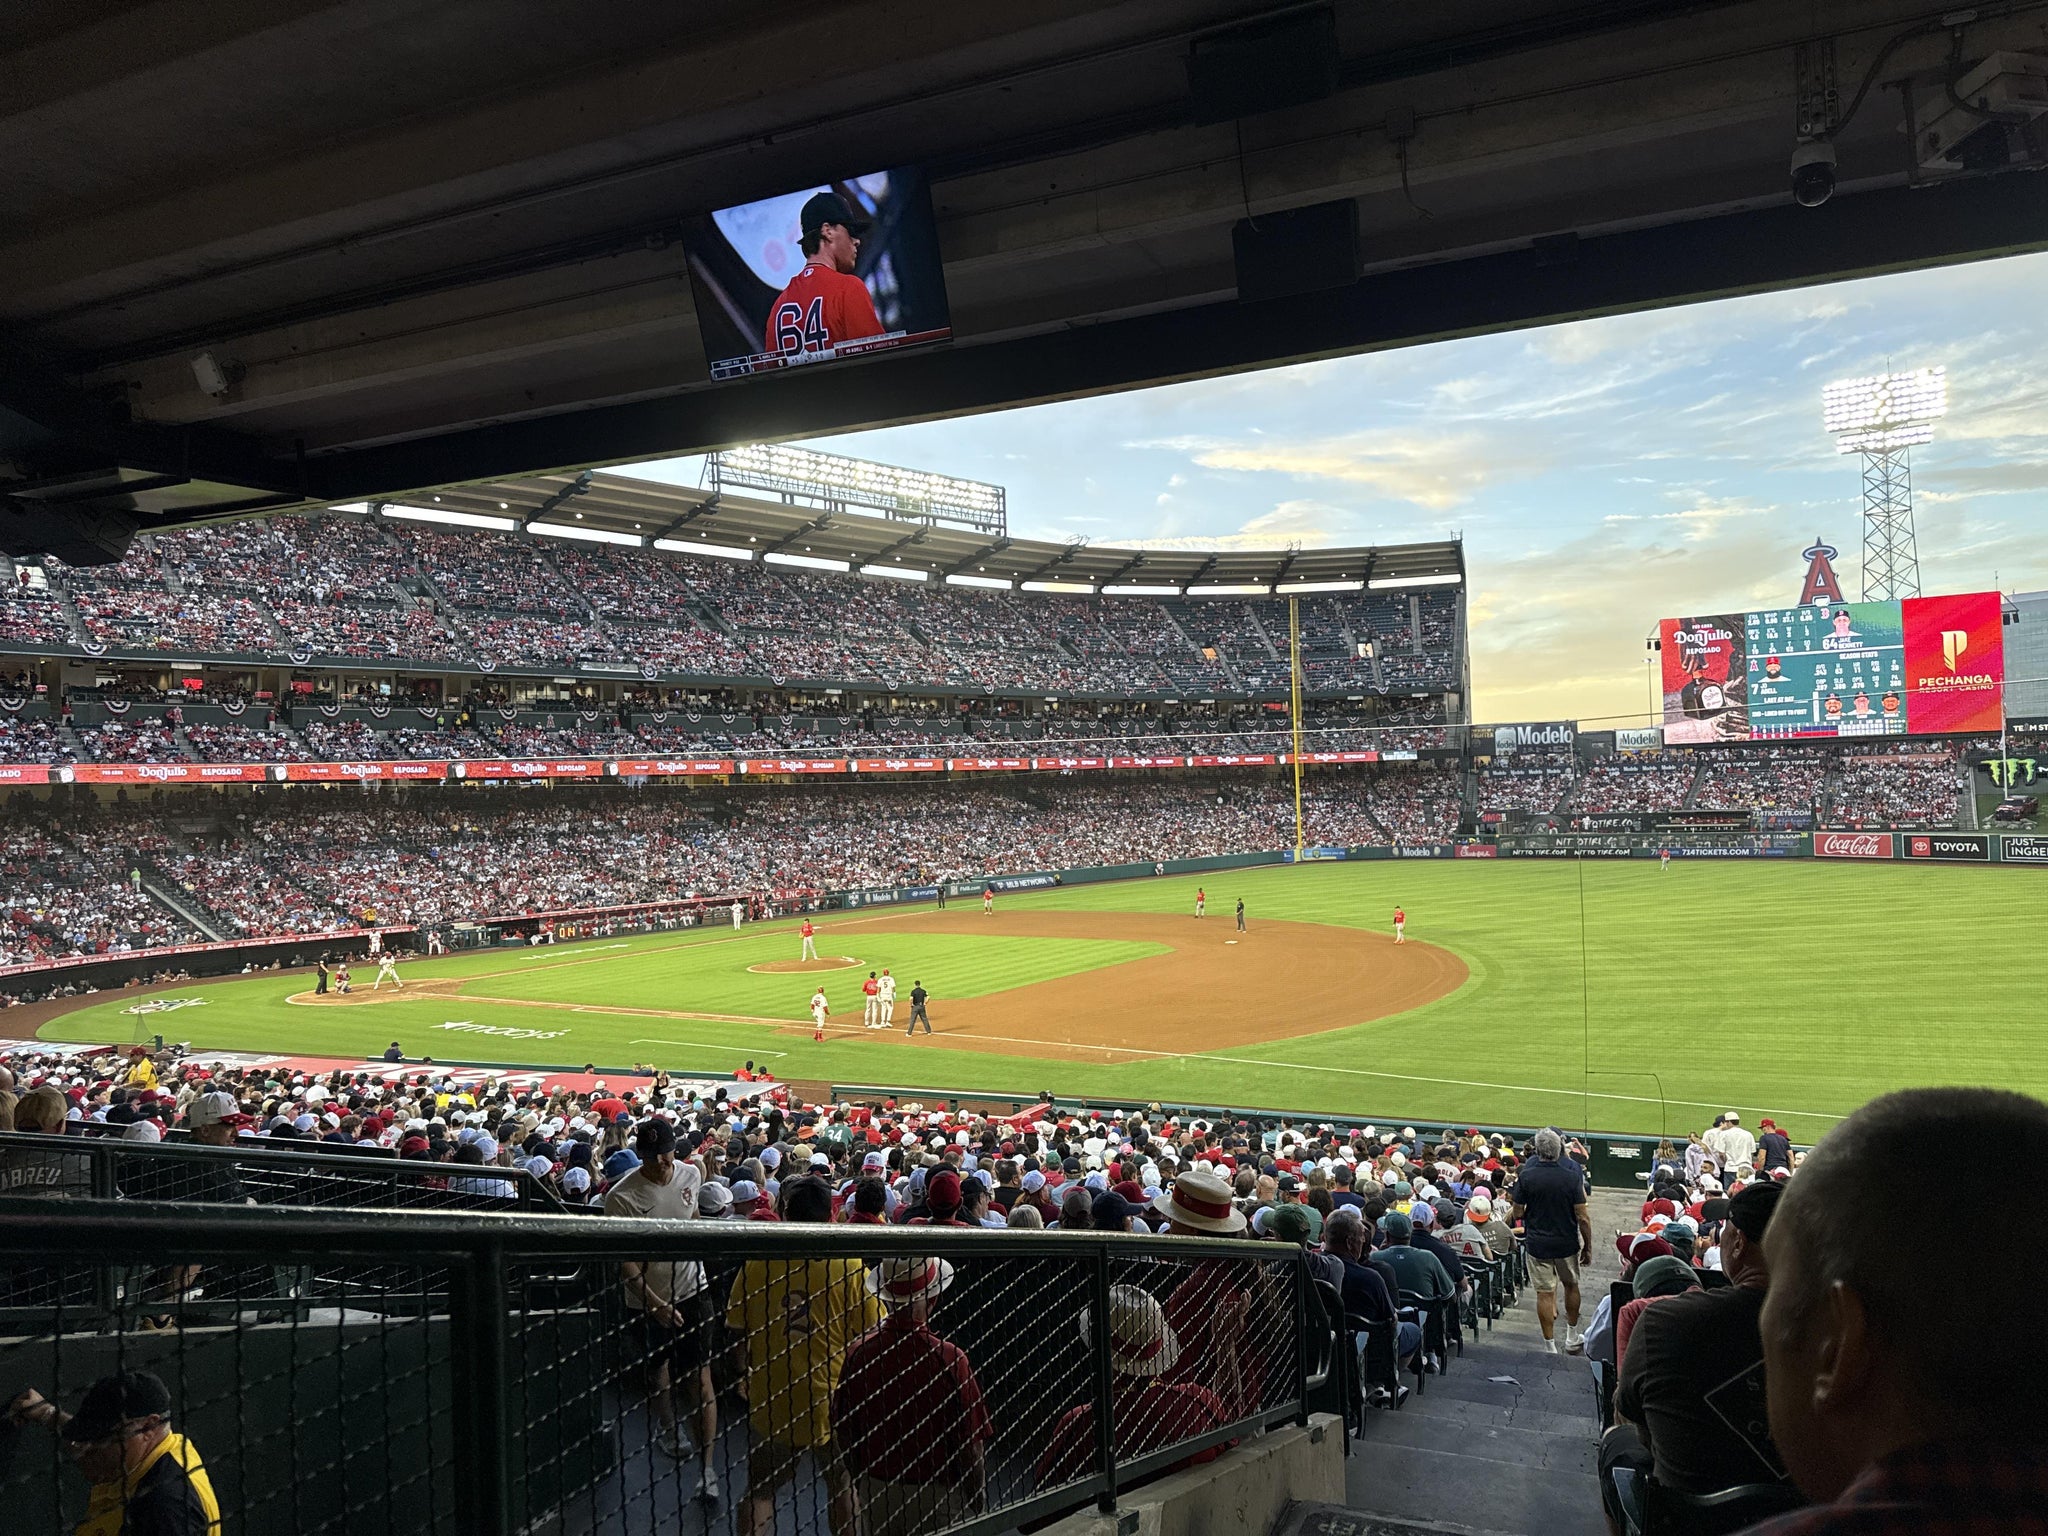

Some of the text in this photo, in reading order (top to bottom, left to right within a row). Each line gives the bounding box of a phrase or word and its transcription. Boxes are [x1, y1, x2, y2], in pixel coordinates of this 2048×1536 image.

[776, 296, 829, 354] 64
[778, 359, 784, 367] 0
[740, 366, 746, 374] 5
[1822, 638, 1838, 650] 64
[1686, 646, 1721, 655] REPOSADO
[1839, 652, 1861, 660] SEASON
[1919, 674, 1993, 687] PECHANGA
[1750, 683, 1759, 695] 7
[1517, 725, 1574, 745] Modelo
[1619, 733, 1657, 745] Modelo
[201, 767, 243, 776] REPOSADO
[393, 765, 428, 774] REPOSADO
[556, 764, 586, 772] REPOSADO
[1824, 834, 1882, 856] Coca-Cola
[2010, 838, 2035, 846] JUST
[1402, 847, 1430, 857] Modelo
[1934, 842, 1980, 853] TOYOTA
[2010, 846, 2048, 856] INGRE
[1006, 878, 1047, 889] MLB NETWORK
[872, 893, 891, 902] Modelo
[883, 981, 888, 989] 5
[827, 1128, 843, 1143] 34
